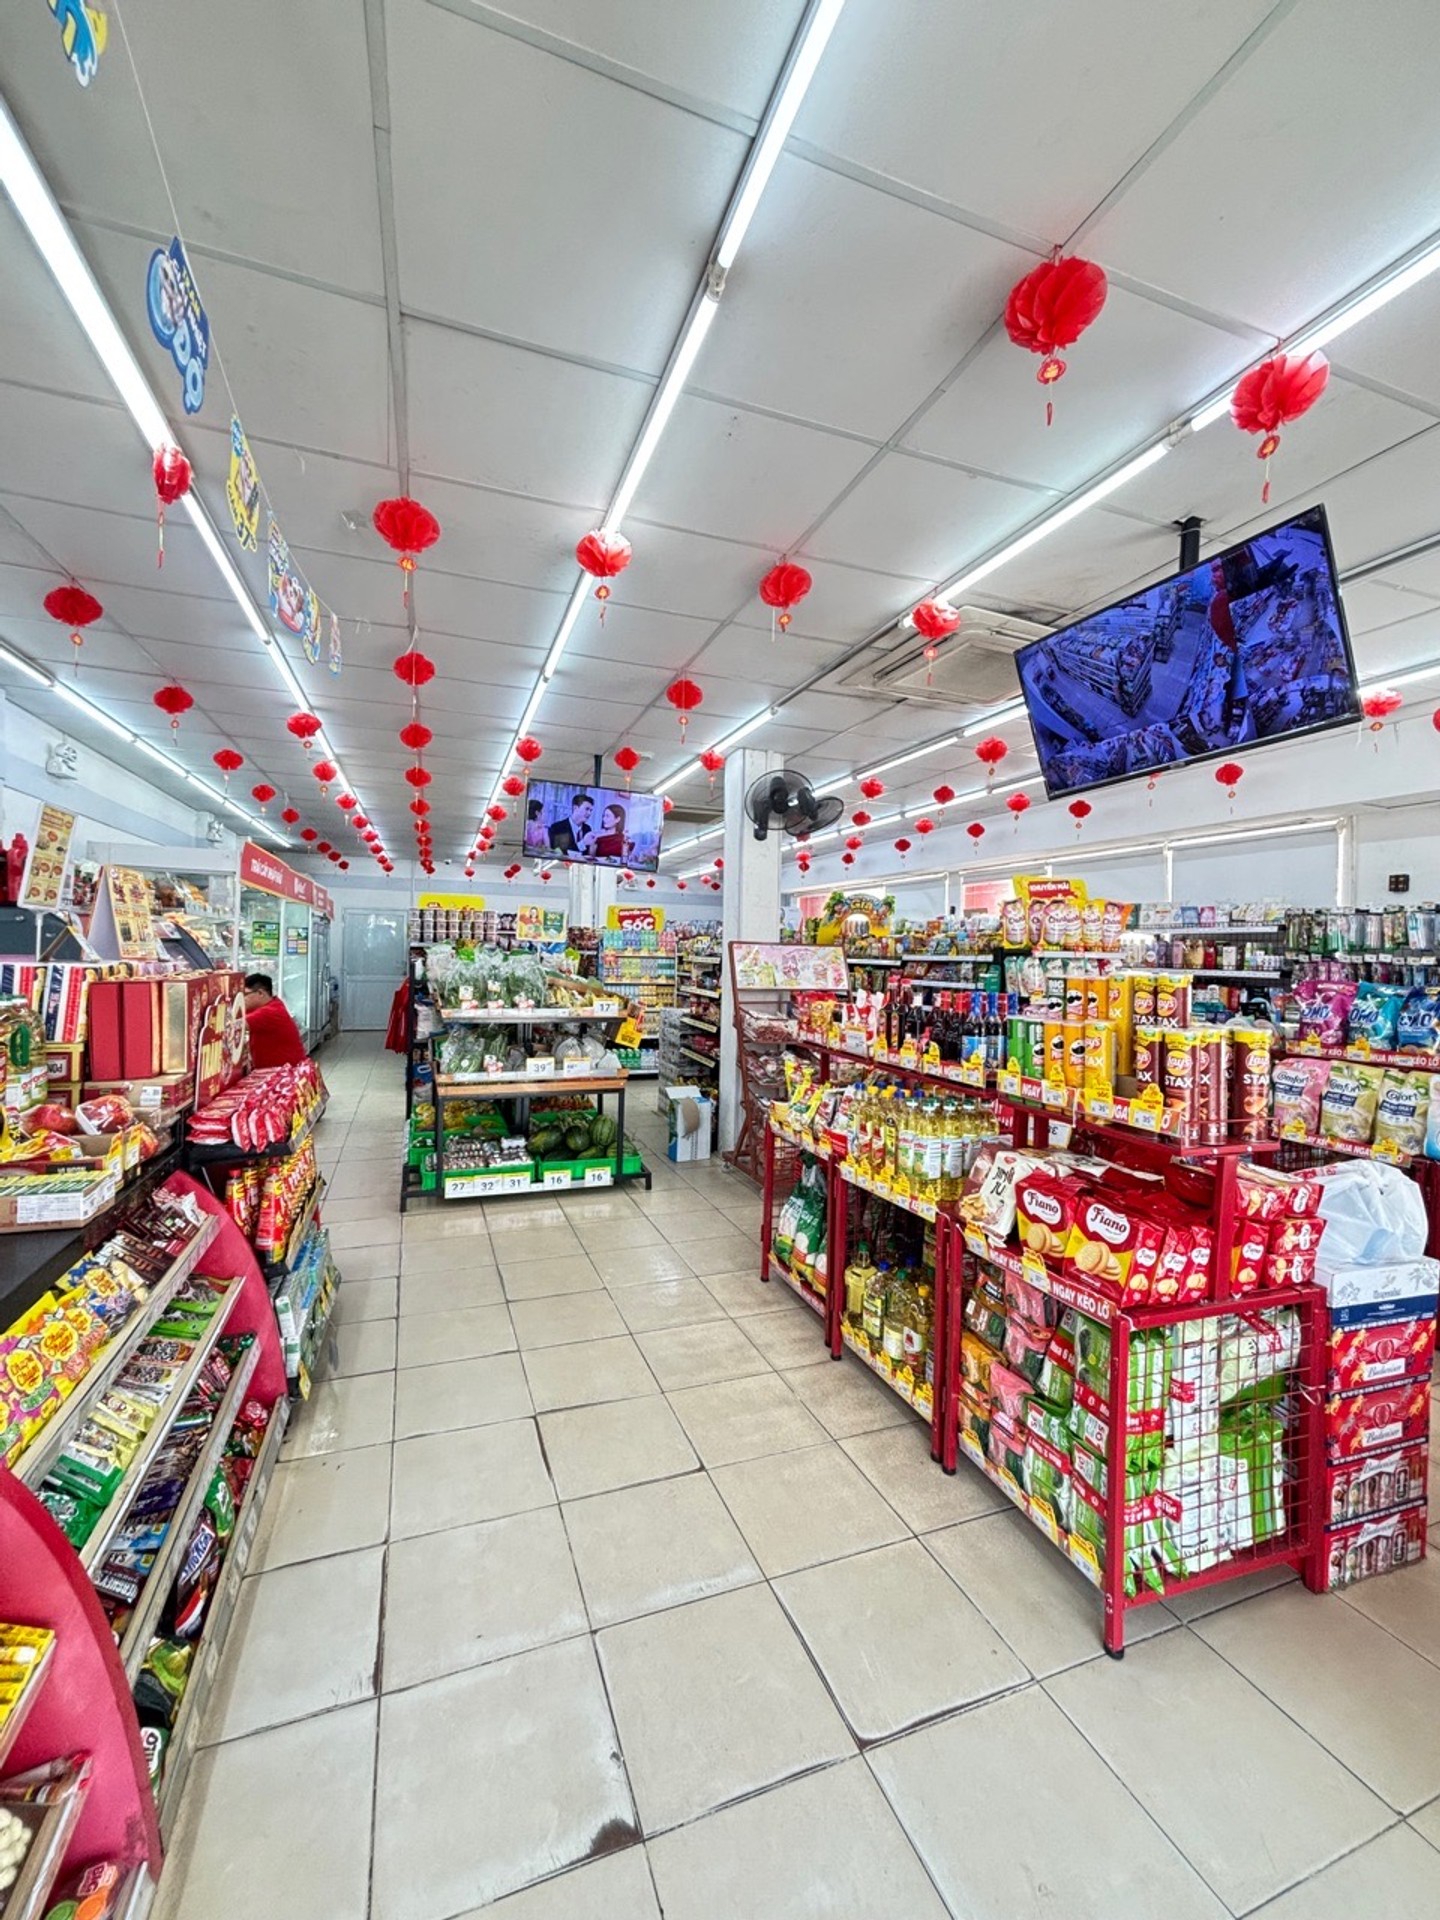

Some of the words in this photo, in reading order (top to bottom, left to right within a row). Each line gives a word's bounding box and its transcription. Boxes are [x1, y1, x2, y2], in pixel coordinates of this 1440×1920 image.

[1156, 1016, 1179, 1028] TAX
[1165, 1074, 1194, 1090] STAX
[1027, 1190, 1059, 1215] Fiano
[1091, 1205, 1128, 1233] Fiano
